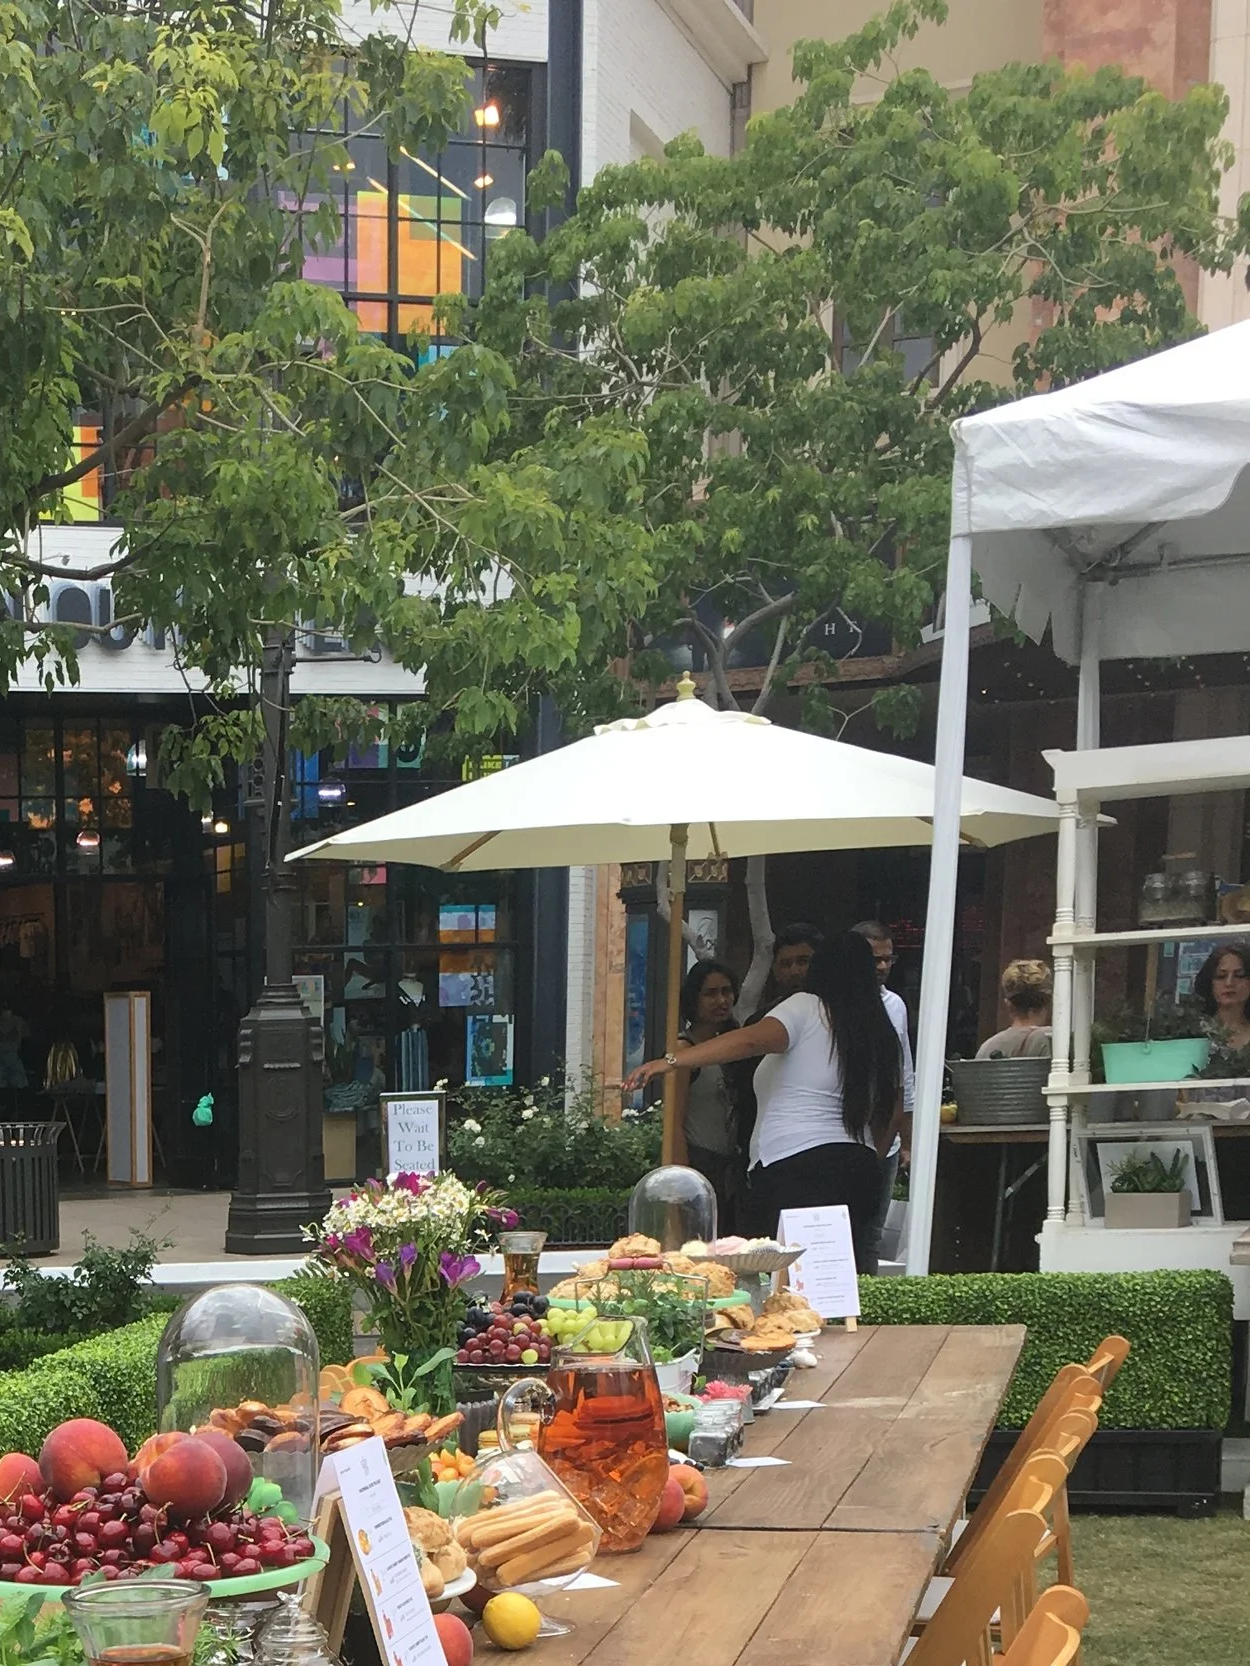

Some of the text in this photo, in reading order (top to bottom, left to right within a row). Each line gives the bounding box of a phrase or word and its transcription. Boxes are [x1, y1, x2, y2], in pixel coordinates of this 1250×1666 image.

[393, 1103, 433, 1116] Please
[398, 1122, 429, 1134] Wait
[393, 1139, 435, 1153] To Be
[394, 1157, 435, 1171] Seated
